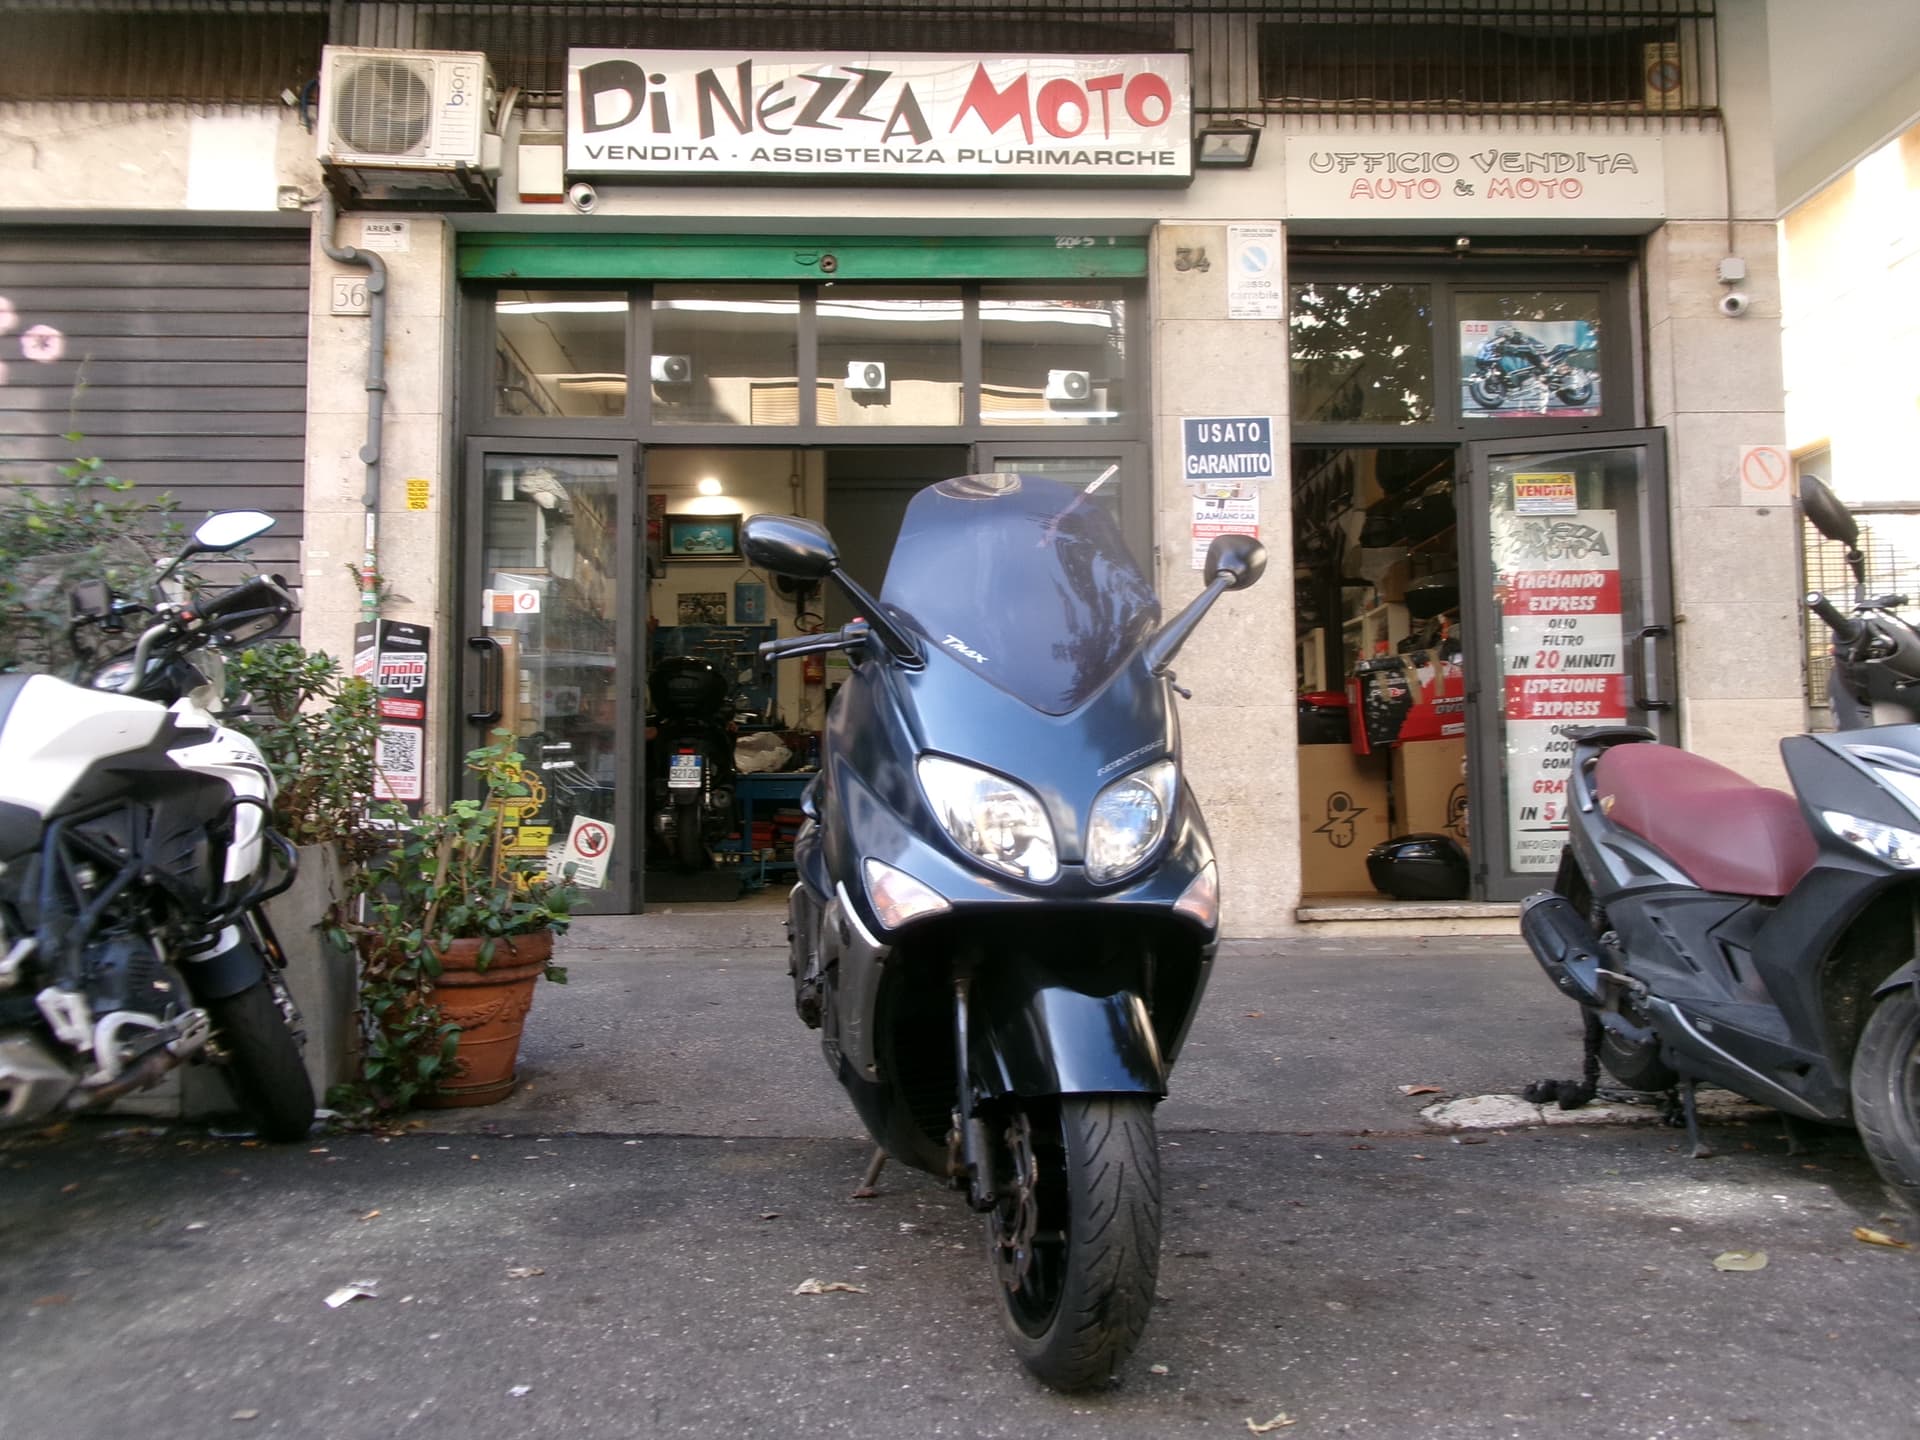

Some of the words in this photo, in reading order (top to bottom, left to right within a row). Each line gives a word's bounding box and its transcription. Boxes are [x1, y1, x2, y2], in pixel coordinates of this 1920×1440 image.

[446, 66, 466, 106] bion
[949, 61, 1173, 145] MOTO
[585, 145, 719, 161] VENDITA
[750, 147, 946, 164] ASSISTENZA
[957, 148, 1176, 166] PLURIMARCHE
[1309, 151, 1460, 174] UFFICIO
[1470, 148, 1638, 175] VENDITA
[1350, 177, 1442, 200] AUTO
[1453, 178, 1475, 198] &
[1487, 177, 1584, 200] MOTO
[1175, 247, 1211, 273] 34
[335, 284, 367, 307] 36
[1198, 422, 1261, 443] USATO
[1187, 453, 1271, 474] GARANTITO
[1516, 485, 1574, 497] VENDITA
[1196, 511, 1240, 520] DAMIANO
[1517, 573, 1605, 589] TAGLIANDO
[1529, 596, 1597, 611] EXPRESS
[1548, 618, 1577, 629] OLIO
[1542, 635, 1584, 647] FILTRO
[1512, 655, 1529, 669] IN
[1536, 650, 1560, 669] 20
[1563, 653, 1616, 669] MINUTI
[382, 662, 423, 675] moto
[380, 675, 422, 691] days
[1523, 678, 1608, 694] ISPEZIONE
[1532, 701, 1602, 716] EXPRESS
[1545, 741, 1577, 753] ACQU
[1542, 758, 1572, 770] GOM
[1533, 779, 1570, 794] GRA
[1520, 807, 1538, 820] IN
[1543, 802, 1556, 821] 5
